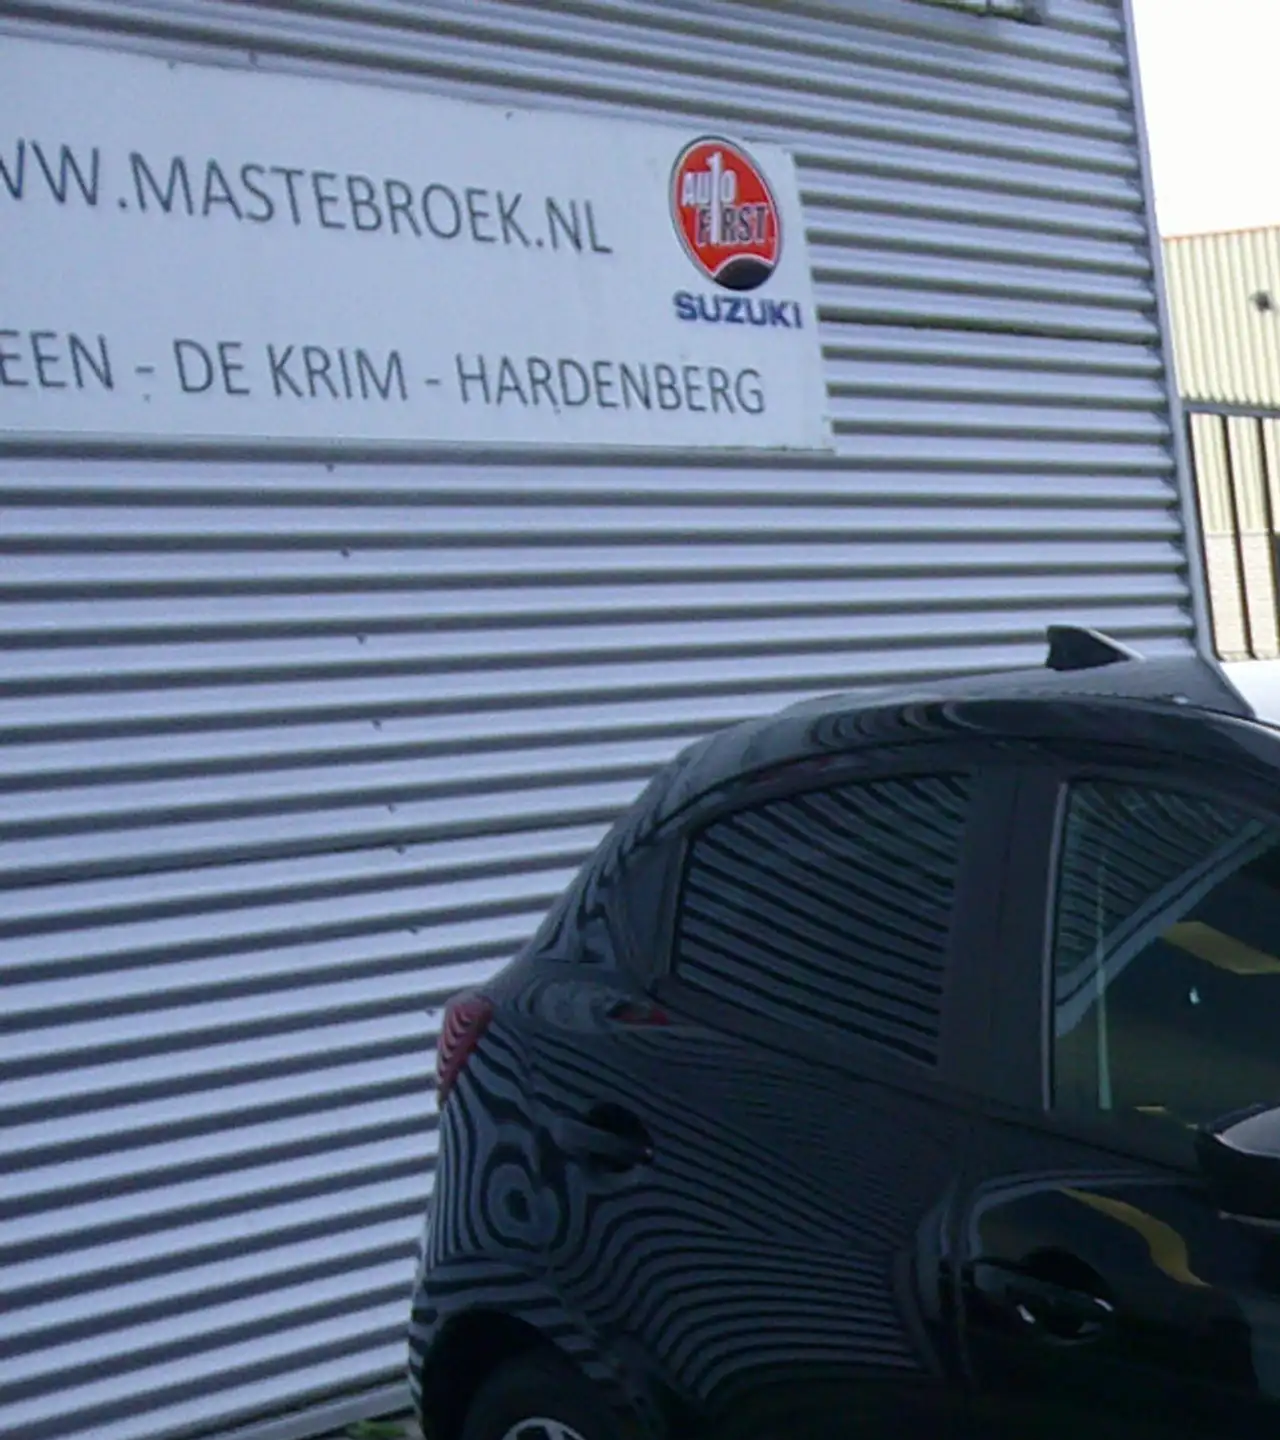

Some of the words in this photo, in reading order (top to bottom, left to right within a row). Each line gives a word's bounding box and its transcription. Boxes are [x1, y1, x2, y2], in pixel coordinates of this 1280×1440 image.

[673, 290, 804, 329] SUZUKI
[0, 328, 115, 391] EEN
[172, 338, 252, 397] DE
[266, 343, 410, 403] KRIM
[455, 353, 766, 415] HARDENBERG
